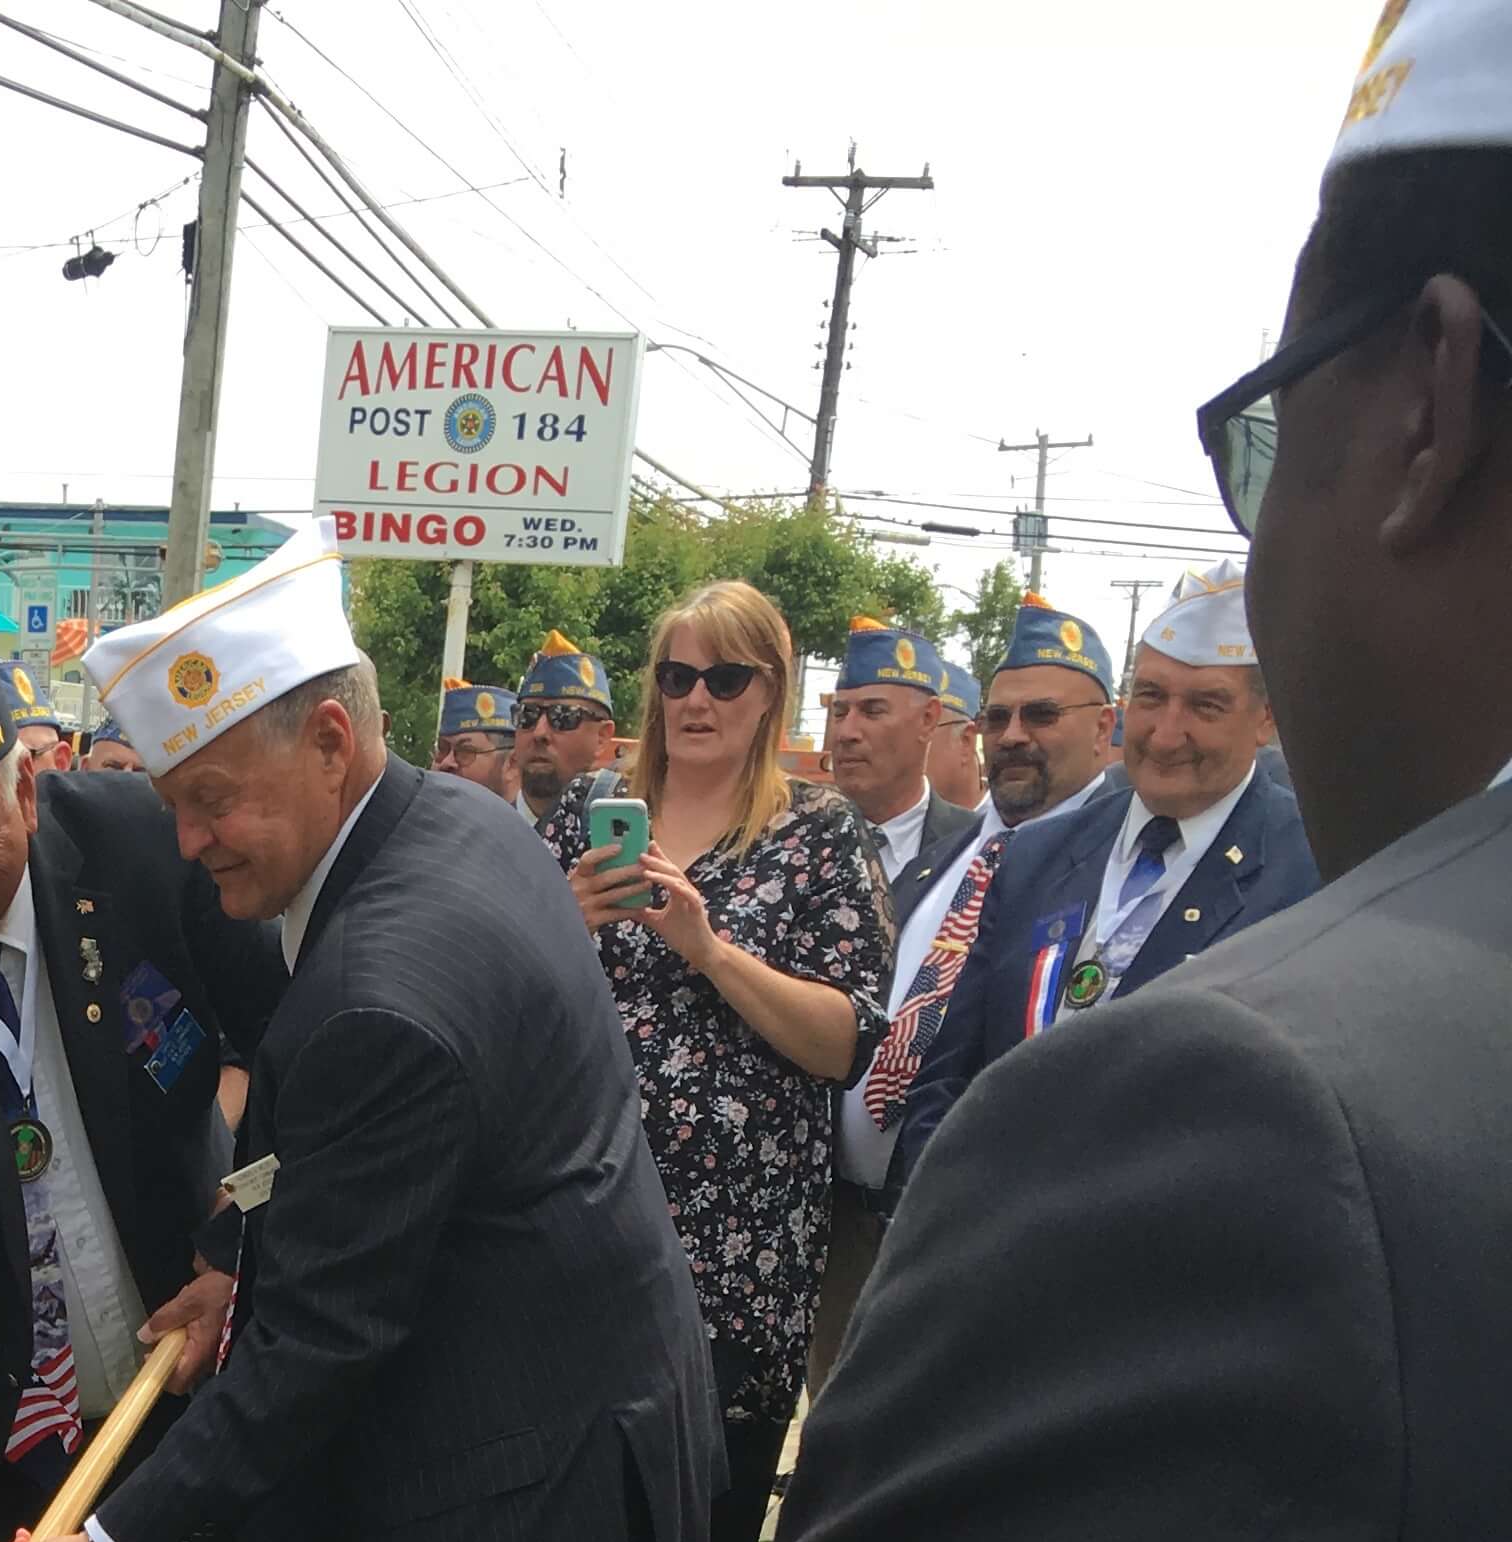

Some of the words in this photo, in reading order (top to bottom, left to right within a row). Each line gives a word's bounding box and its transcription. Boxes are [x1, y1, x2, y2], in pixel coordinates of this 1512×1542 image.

[338, 339, 614, 406] AMERICAN
[349, 406, 432, 437] POST
[512, 412, 588, 443] 184
[368, 460, 571, 497] LEGION
[330, 510, 487, 546] BINGO
[504, 534, 554, 550] 7:30
[563, 536, 598, 551] PM
[522, 517, 583, 534] WED.
[876, 667, 900, 679] NEW
[162, 723, 199, 756] NEW
[204, 676, 266, 729] JERSEY
